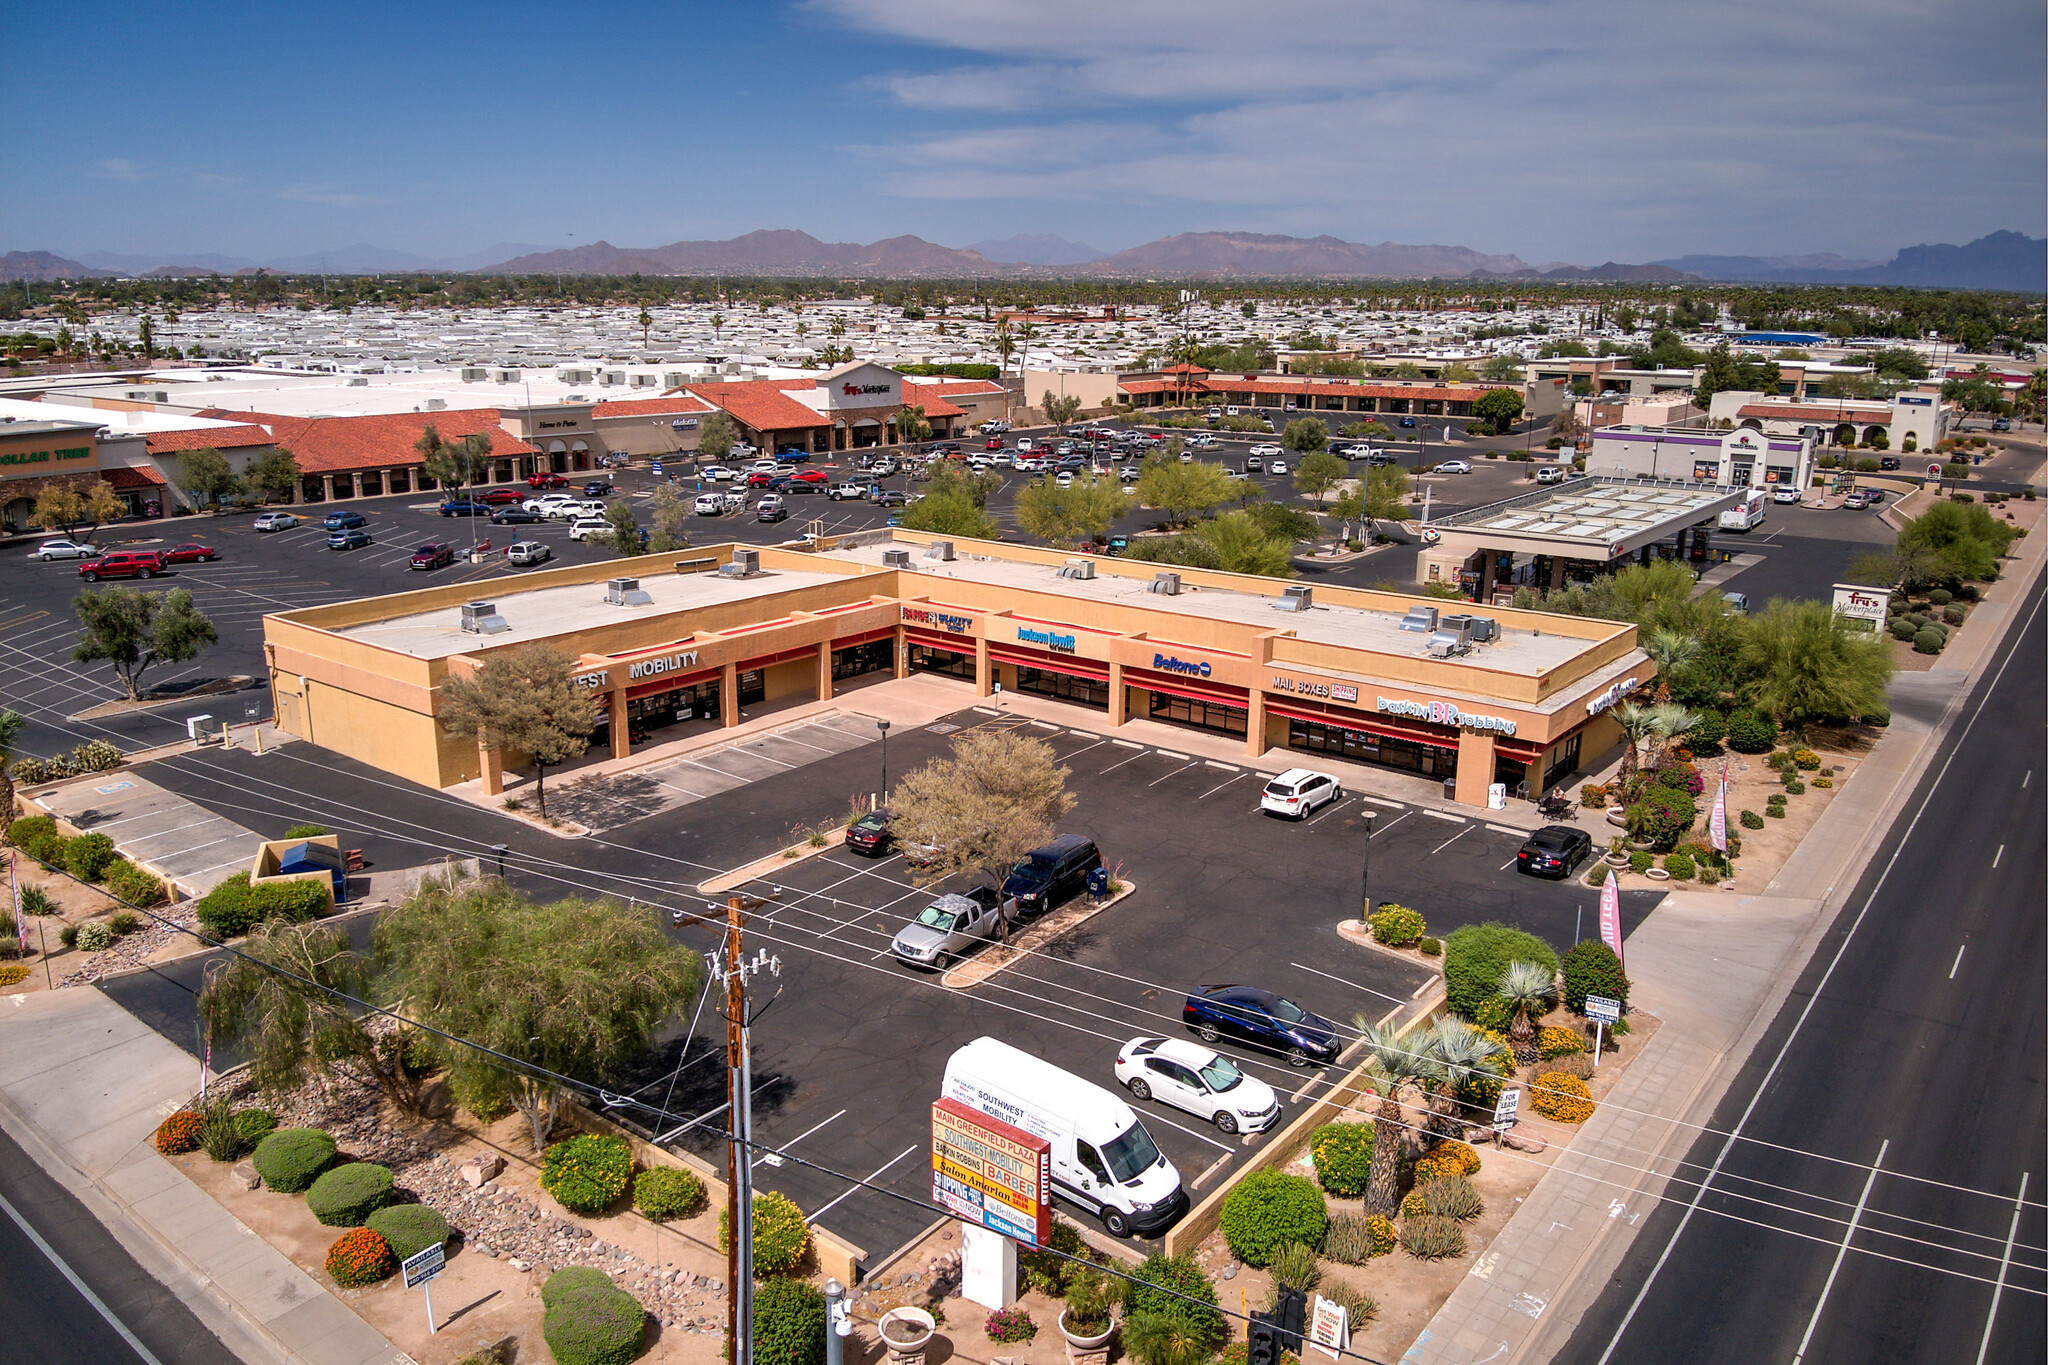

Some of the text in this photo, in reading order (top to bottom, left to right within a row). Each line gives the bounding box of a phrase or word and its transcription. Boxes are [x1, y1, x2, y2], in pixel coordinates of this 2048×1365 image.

[0, 447, 90, 466] OLLAR TREE
[1834, 601, 1884, 615] Marketplace
[1848, 591, 1879, 607] fry's
[939, 613, 972, 627] BEAUTY
[1018, 626, 1075, 649] Jackson Hewitt
[629, 650, 698, 679] MOBILITY
[1153, 653, 1200, 675] Beltone
[1273, 677, 1329, 697] MAIL BOXES
[1333, 685, 1355, 695] SHIPPING
[1377, 696, 1516, 735] baskin BR robbins
[1587, 996, 1618, 1007] AVAILABLE
[978, 1090, 1024, 1118] SOUTHWEST
[1501, 1100, 1517, 1109] LEASE
[1505, 1093, 1516, 1101] FOR
[982, 1103, 1017, 1125] MOBILITY
[935, 1109, 1035, 1162] MAIN GREENFIELD PLAZA
[935, 1142, 980, 1171] BASKIN ROBBINS
[944, 1128, 1023, 1175] SOUTHWEST MOBILITY
[934, 1170, 968, 1200] SHIPPING
[940, 1161, 967, 1180] Salon
[968, 1173, 1010, 1201] Amarian
[988, 1166, 1035, 1198] BARBER
[935, 1188, 944, 1199] Get
[945, 1193, 958, 1204] Well
[965, 1203, 982, 1216] NOW
[1012, 1191, 1029, 1203] HAIR
[1012, 1198, 1029, 1210] SALON
[996, 1204, 1025, 1225] Beltone
[988, 1214, 1032, 1243] Jackson Hewitt
[407, 1245, 442, 1268] AVAILABLE
[1324, 1315, 1339, 1326] NOW
[1327, 1311, 1339, 1320] Well
